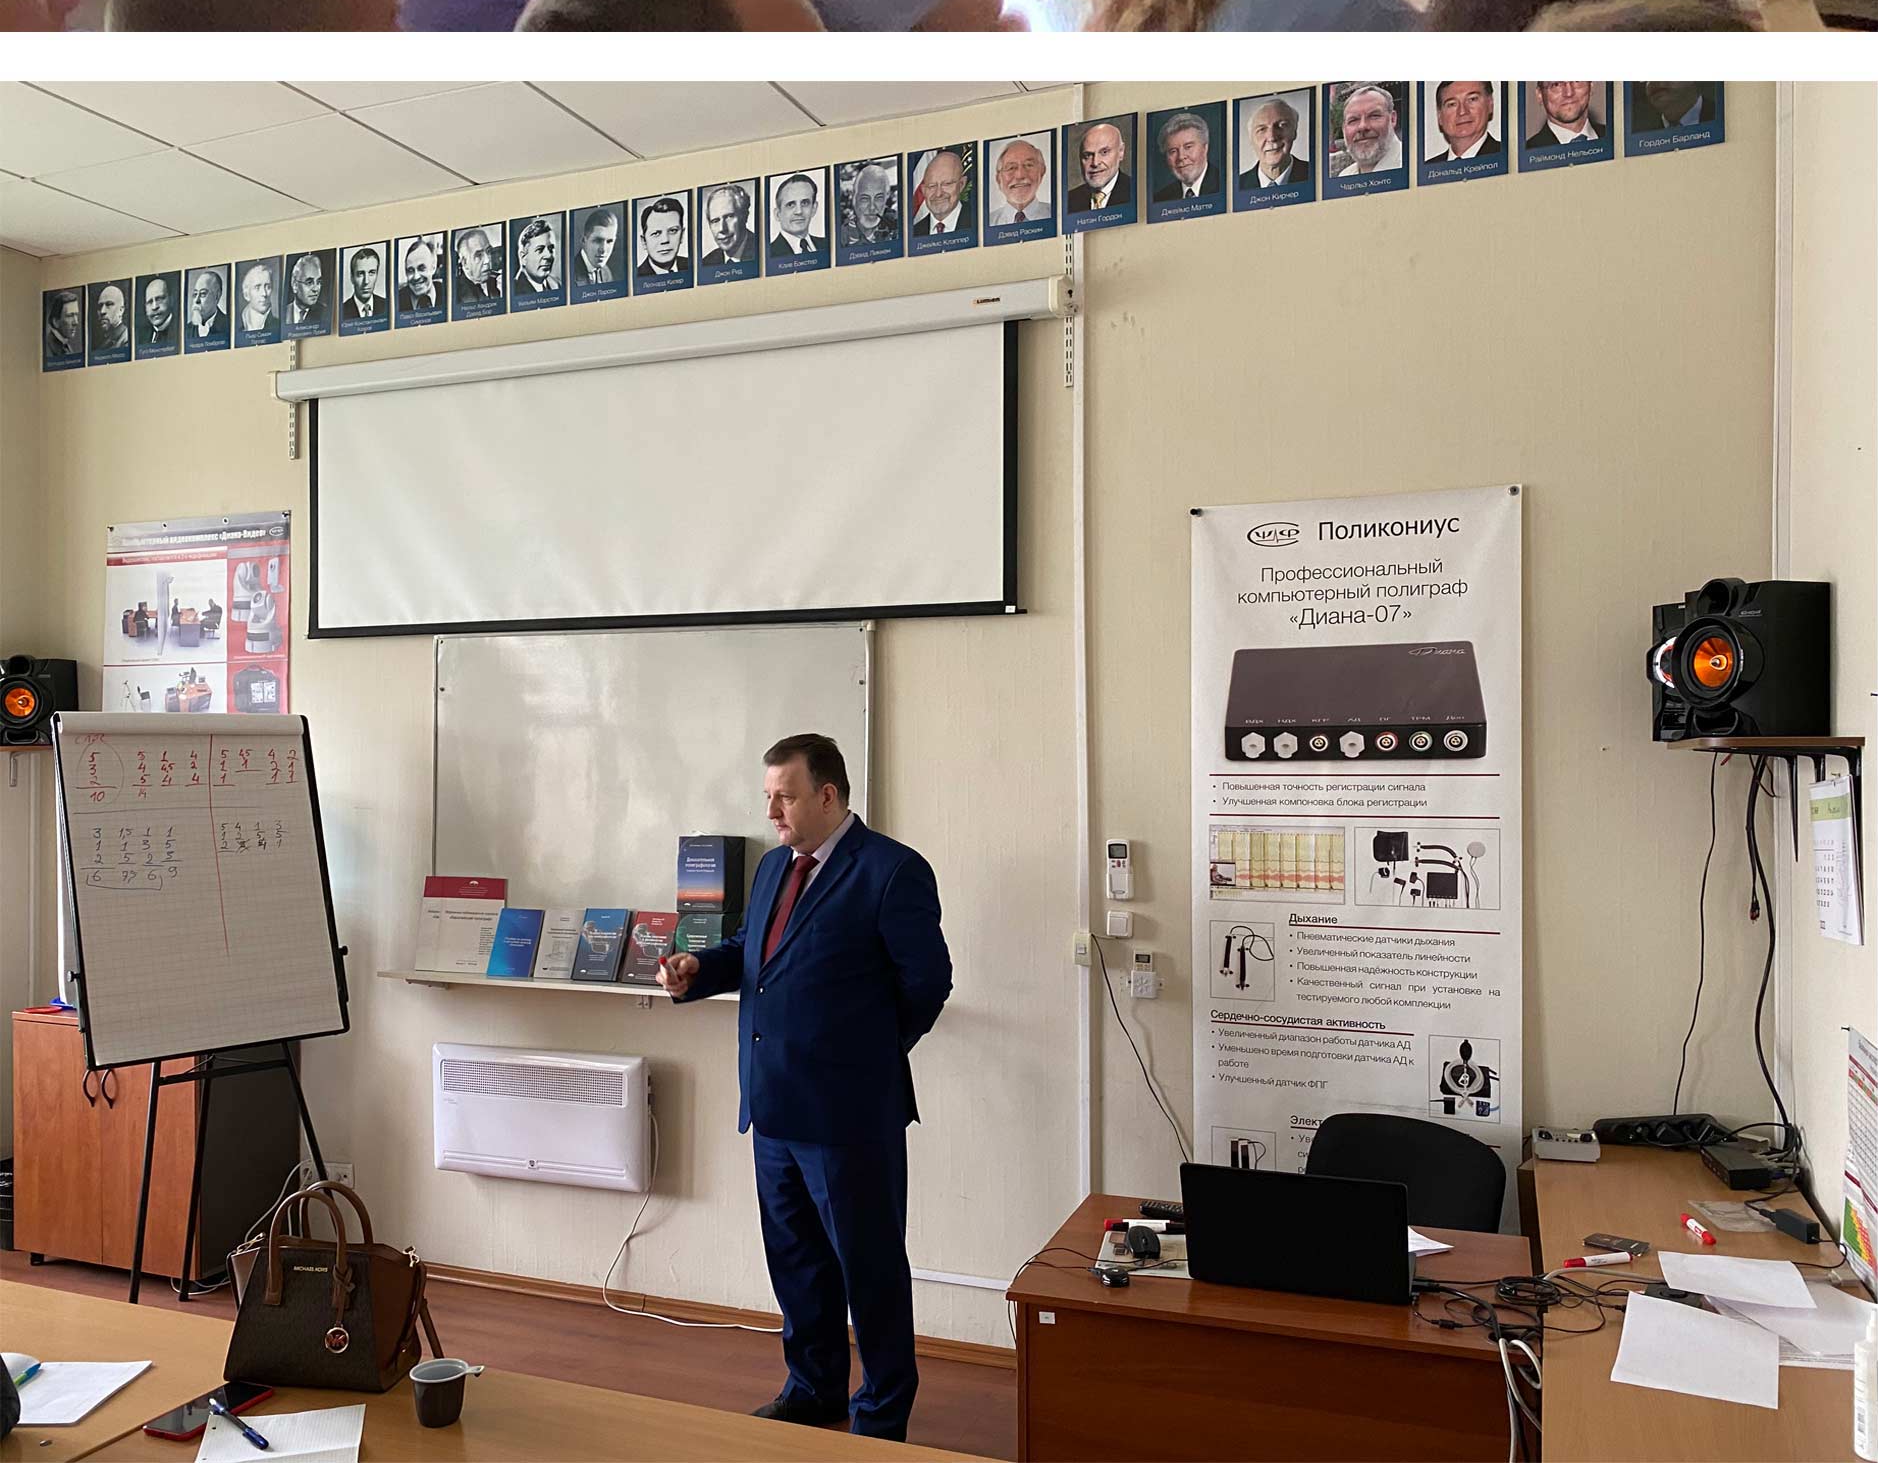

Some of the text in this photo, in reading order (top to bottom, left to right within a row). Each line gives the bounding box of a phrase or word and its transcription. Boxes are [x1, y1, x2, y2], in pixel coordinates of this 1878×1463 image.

[1639, 131, 1710, 150] Гордон Барланд
[1567, 146, 1604, 160] Нельсон
[1428, 167, 1462, 179] Дональд
[1249, 194, 1271, 205] Джон
[1076, 213, 1123, 226] Натан Гордон
[1318, 516, 1460, 541] Поликониус
[1261, 558, 1443, 583] Профессиональный
[1238, 579, 1468, 605] компьютерный полиграф
[1289, 605, 1412, 630] «Диана-07»
[221, 749, 230, 759] 5
[1222, 782, 1426, 793] Повышенная точность регистрации сигнала
[89, 791, 105, 802] 10
[1222, 797, 1427, 808] Улучшенная компоновка блока регистрации
[1289, 913, 1338, 925] Дыхание
[1375, 936, 1413, 946] датчики
[1414, 938, 1455, 948] дыхания
[1297, 947, 1471, 964] Увеличенный показатель линейности
[1297, 962, 1357, 975] Повышенная
[1417, 969, 1478, 980] конструкции
[1297, 977, 1501, 997] Качественный сигнал при установке на
[1297, 992, 1451, 1010] тестируемого любой комплекции
[1210, 1009, 1386, 1031] Сердечно-сосудистая активность
[1218, 1028, 1411, 1051] Увеличенный диапазон работы датчика АД
[1218, 1043, 1270, 1057] Уменьшено
[1271, 1048, 1299, 1060] время
[1300, 1049, 1353, 1062] подготовки
[1354, 1053, 1392, 1064] датчика
[1392, 1055, 1408, 1066] АД
[1218, 1058, 1249, 1070] работе
[1218, 1072, 1274, 1085] Улучшенный
[1275, 1077, 1306, 1088] датчик
